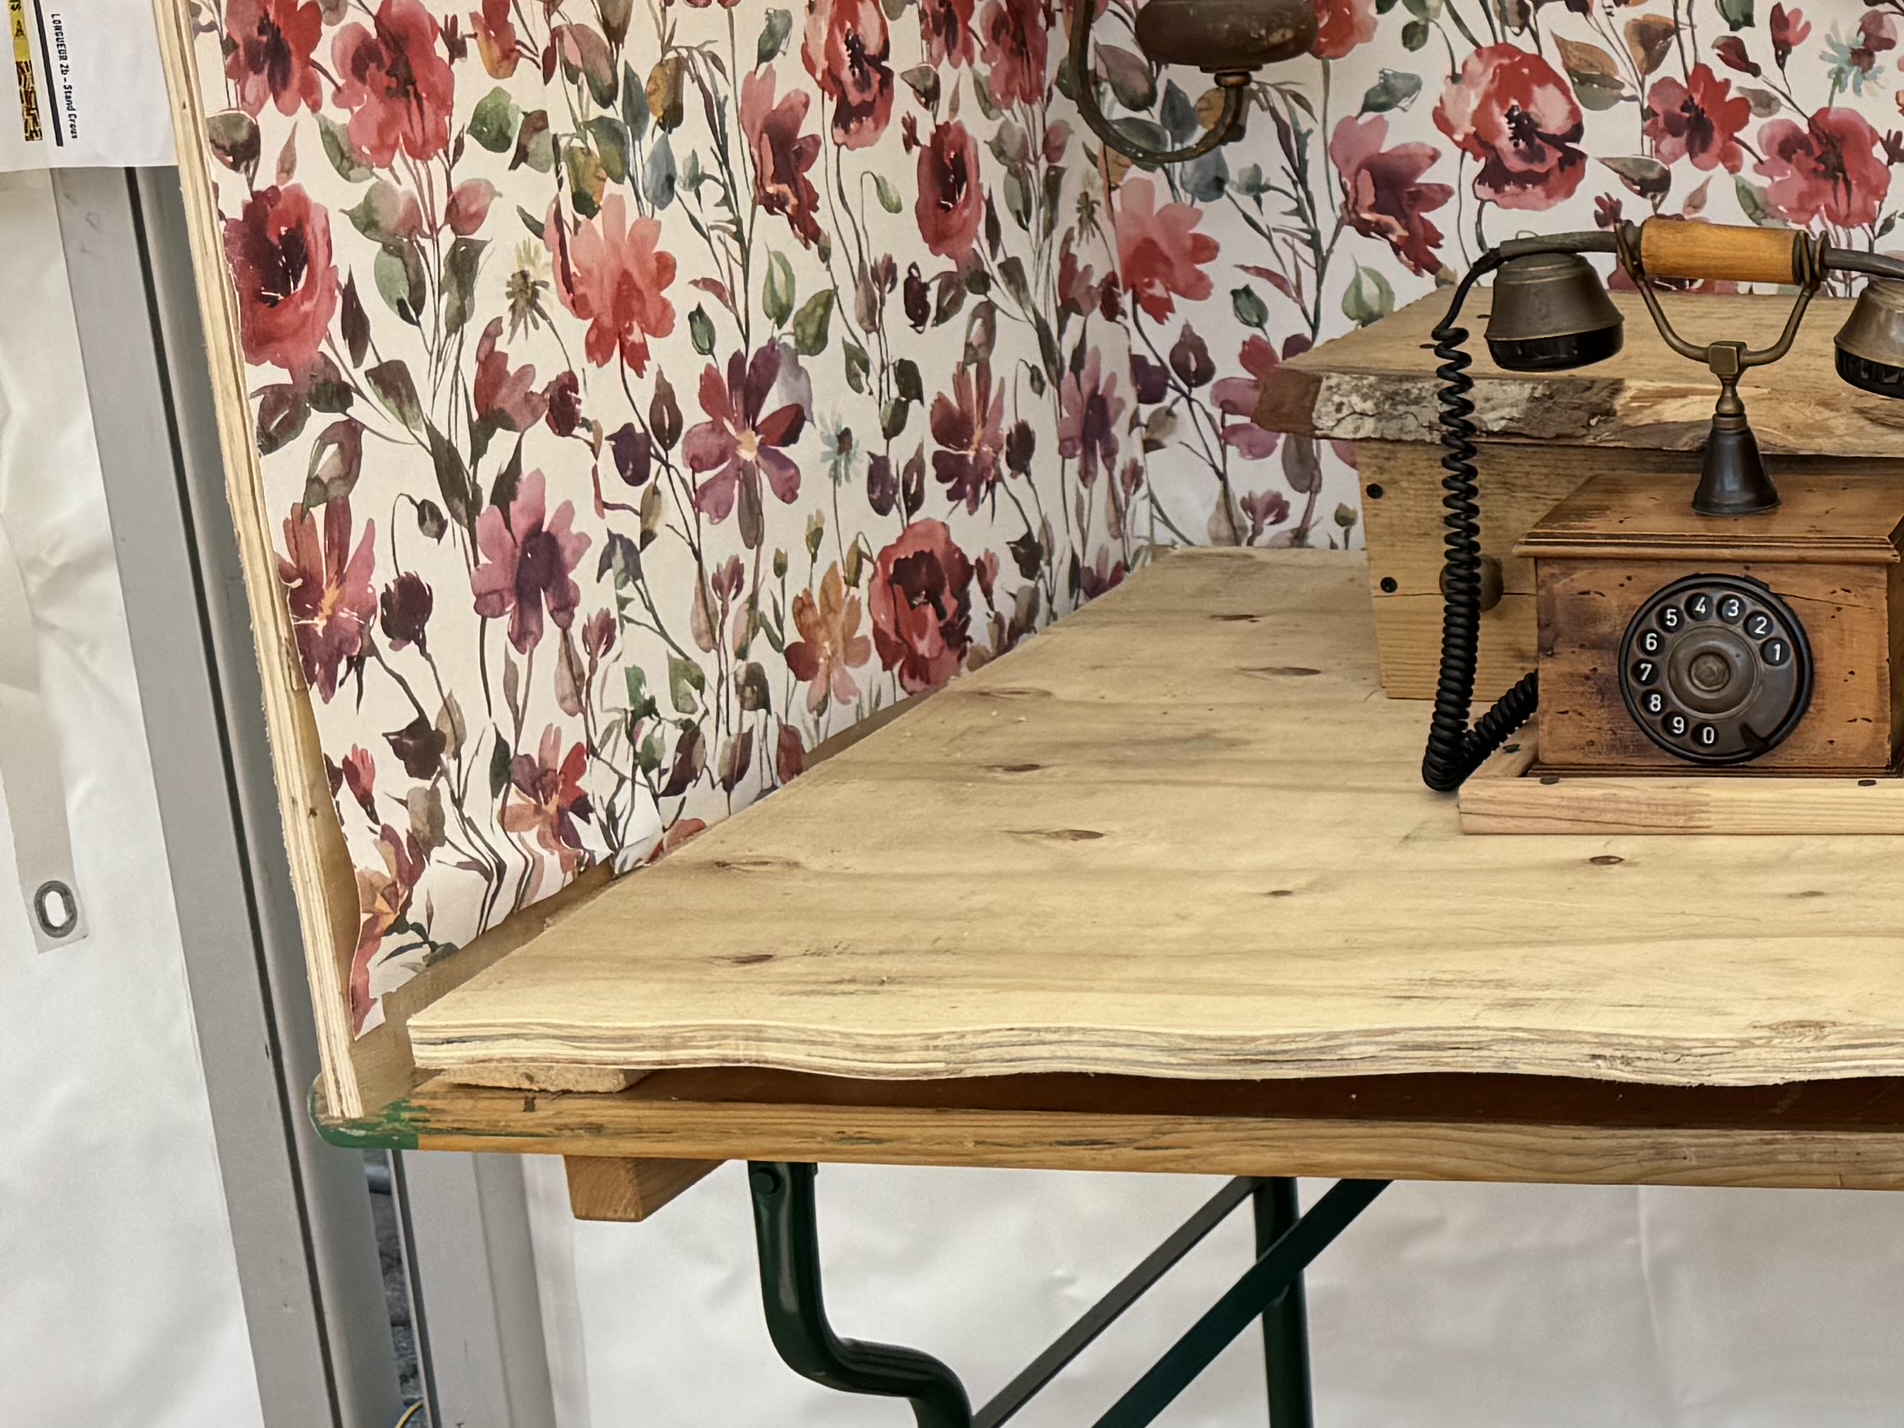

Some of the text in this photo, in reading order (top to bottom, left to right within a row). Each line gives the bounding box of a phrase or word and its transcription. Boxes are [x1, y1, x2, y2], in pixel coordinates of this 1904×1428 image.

[51, 13, 67, 61] LONGUEUR
[60, 63, 69, 75] 2b
[63, 84, 76, 111] Stand
[69, 113, 78, 139] Crous
[1695, 596, 1706, 614] 4
[1727, 599, 1740, 617] 3
[1666, 609, 1677, 627] 5
[1754, 616, 1768, 634] 2
[1645, 633, 1658, 650] 6
[1773, 643, 1781, 661] 1
[1640, 663, 1652, 681] 7
[1649, 694, 1662, 712] 8
[1673, 716, 1685, 734] 9
[1702, 726, 1715, 744] 0
